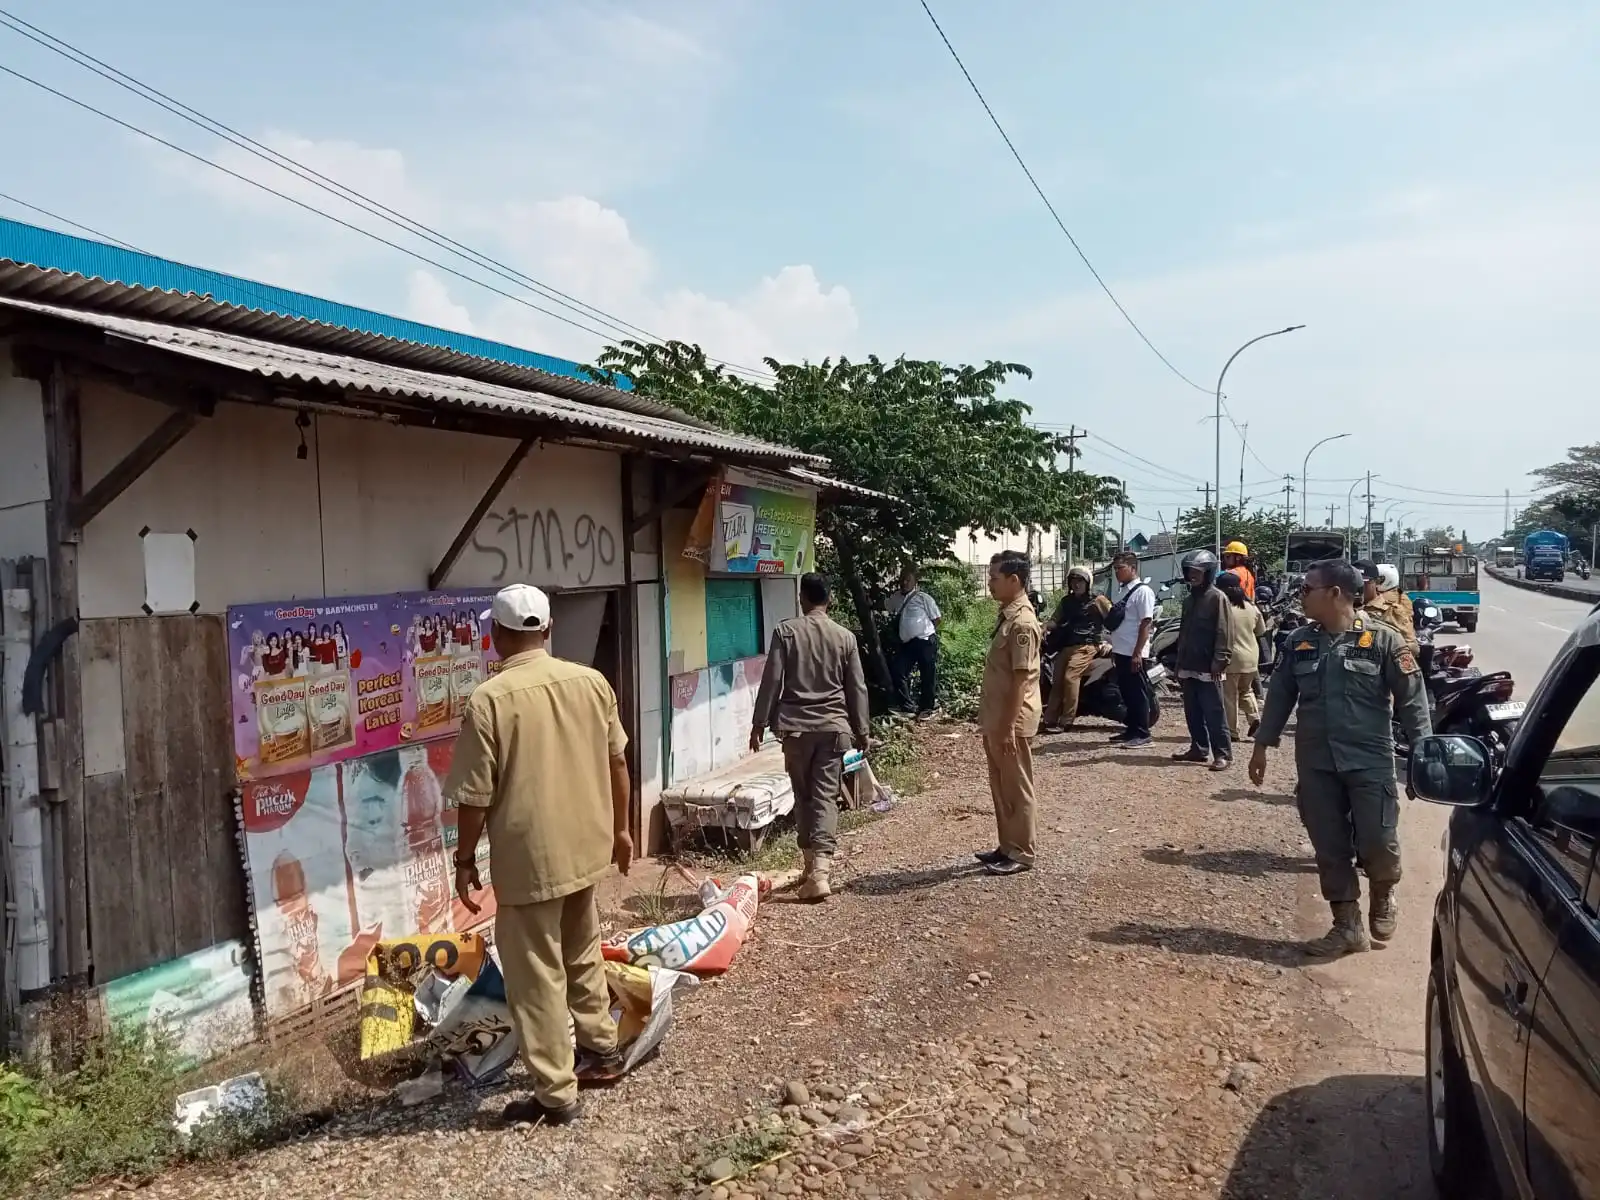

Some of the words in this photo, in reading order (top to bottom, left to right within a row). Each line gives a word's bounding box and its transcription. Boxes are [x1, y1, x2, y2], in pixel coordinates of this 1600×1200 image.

[326, 603, 378, 615] BABYMONSTER
[358, 670, 402, 695] Perfect
[261, 691, 287, 704] Good
[365, 707, 401, 732] Latte!
